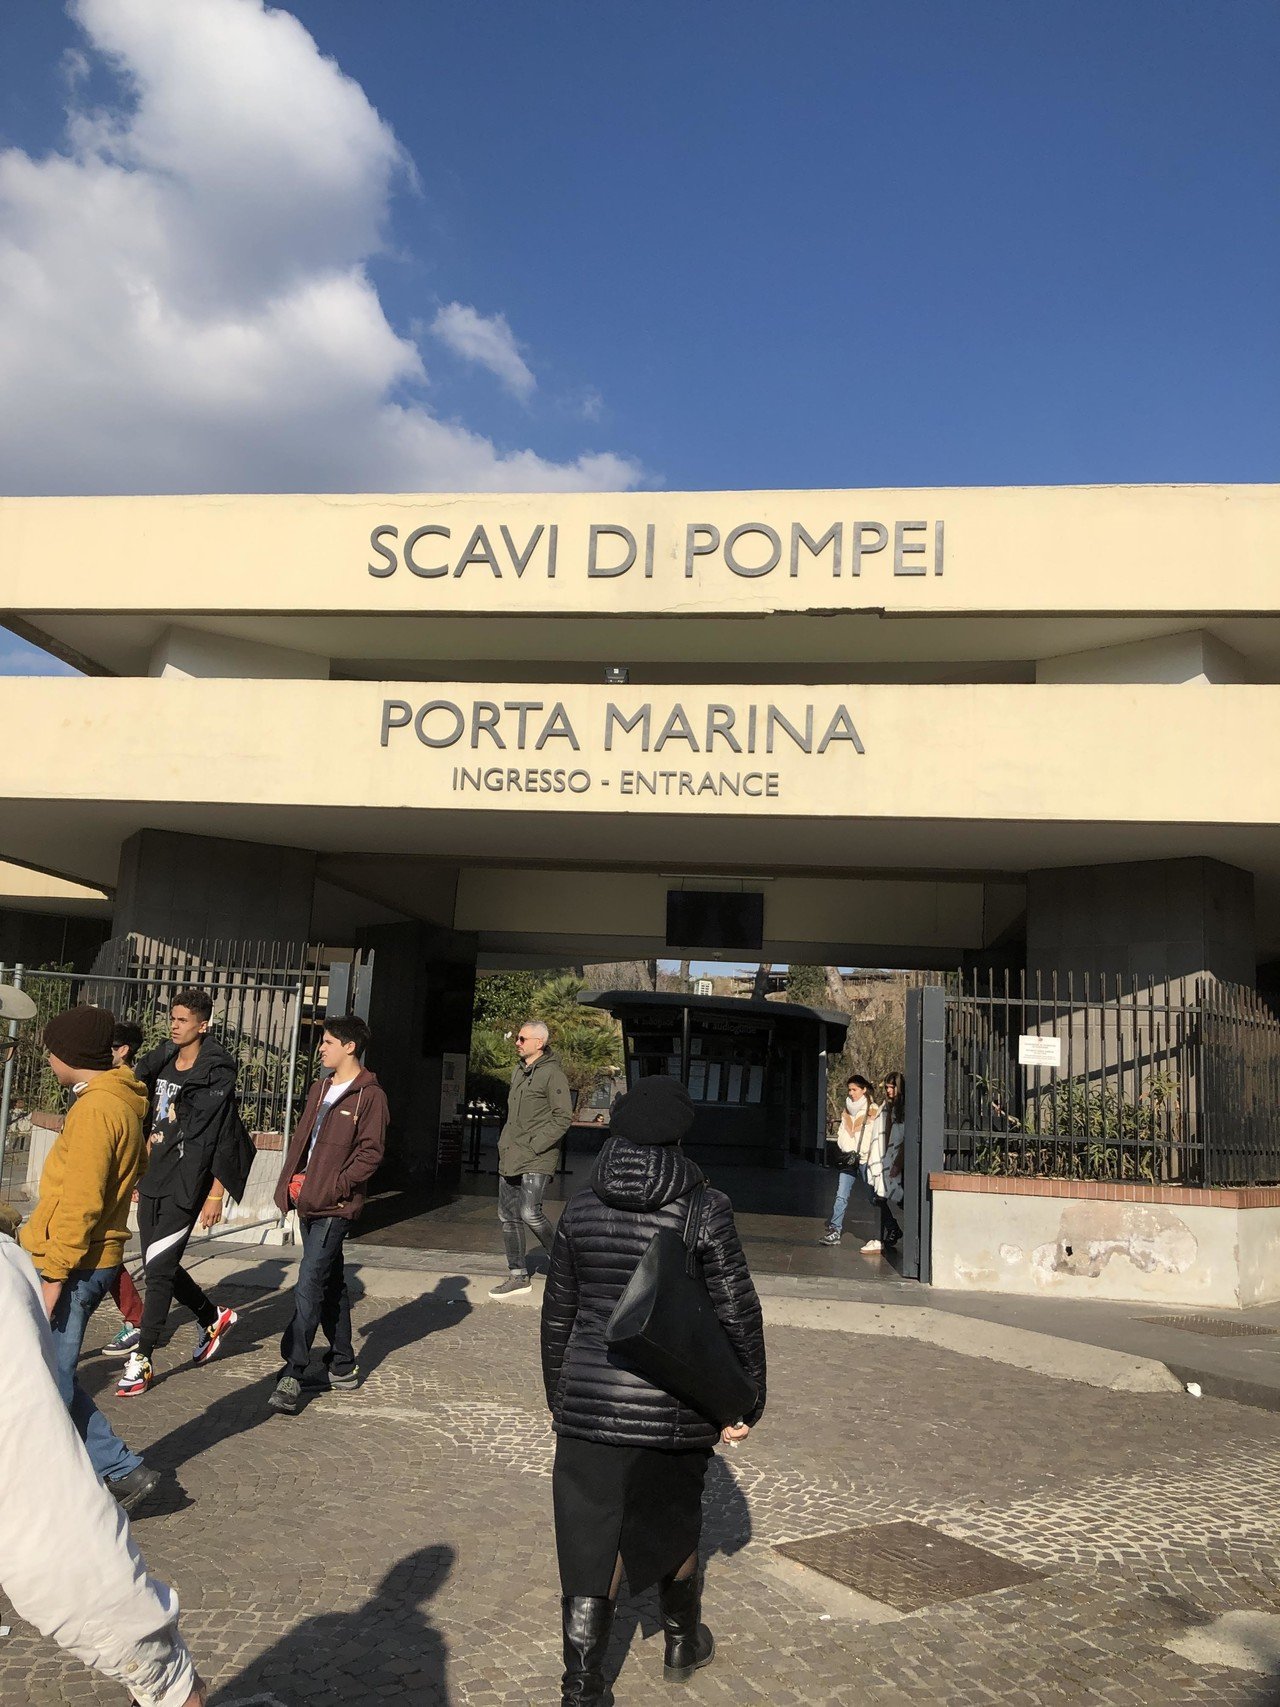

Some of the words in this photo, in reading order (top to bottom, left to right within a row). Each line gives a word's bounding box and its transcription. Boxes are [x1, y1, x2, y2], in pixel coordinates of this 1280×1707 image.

[367, 524, 559, 579] SCAVI
[587, 524, 655, 579] DI
[684, 520, 945, 578] POMPEI
[380, 699, 581, 752] PORTA
[604, 703, 866, 754] MARINA
[452, 767, 591, 793] INGRESSO
[620, 770, 780, 797] ENTRANCE
